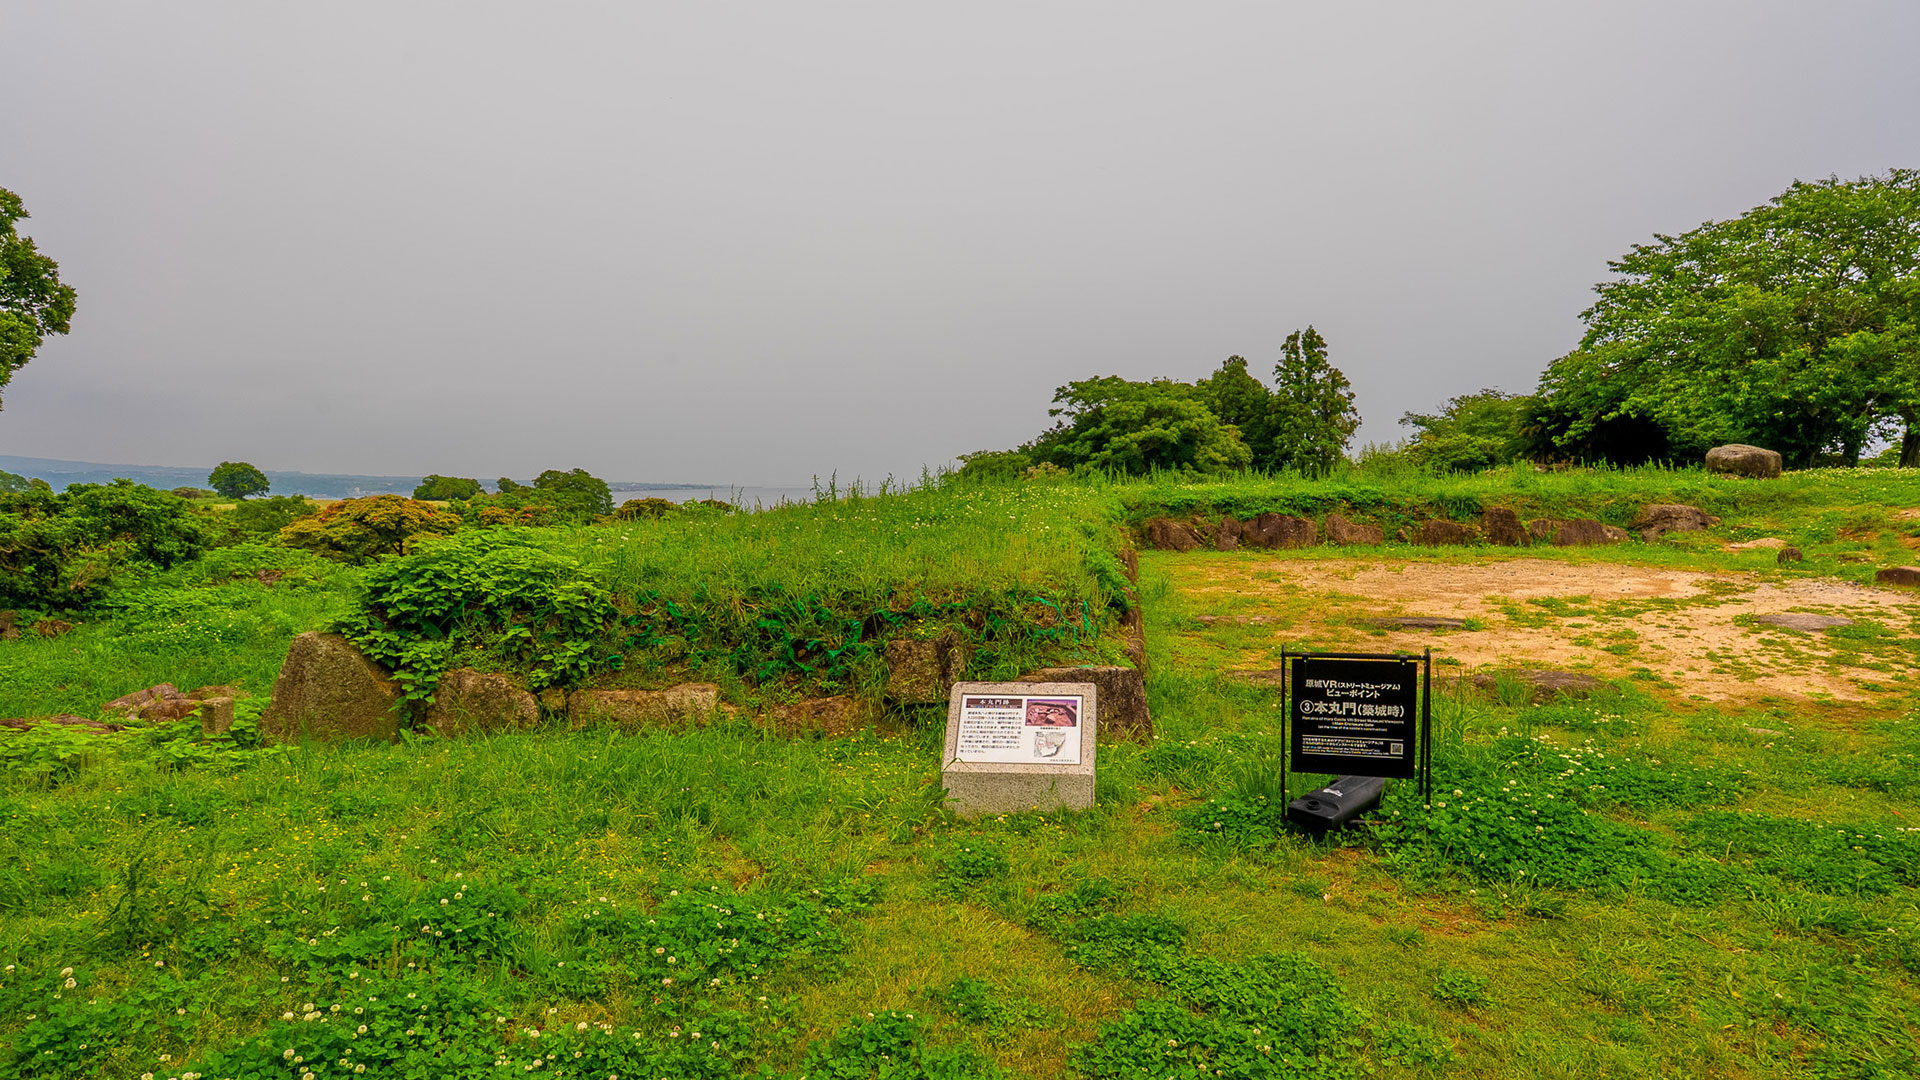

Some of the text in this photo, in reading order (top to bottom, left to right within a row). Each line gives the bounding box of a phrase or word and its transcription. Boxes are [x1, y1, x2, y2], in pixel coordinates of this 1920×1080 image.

[1305, 679, 1400, 690] 原城VR(ストリートミュージアム)
[1326, 688, 1380, 698] ビューポイント
